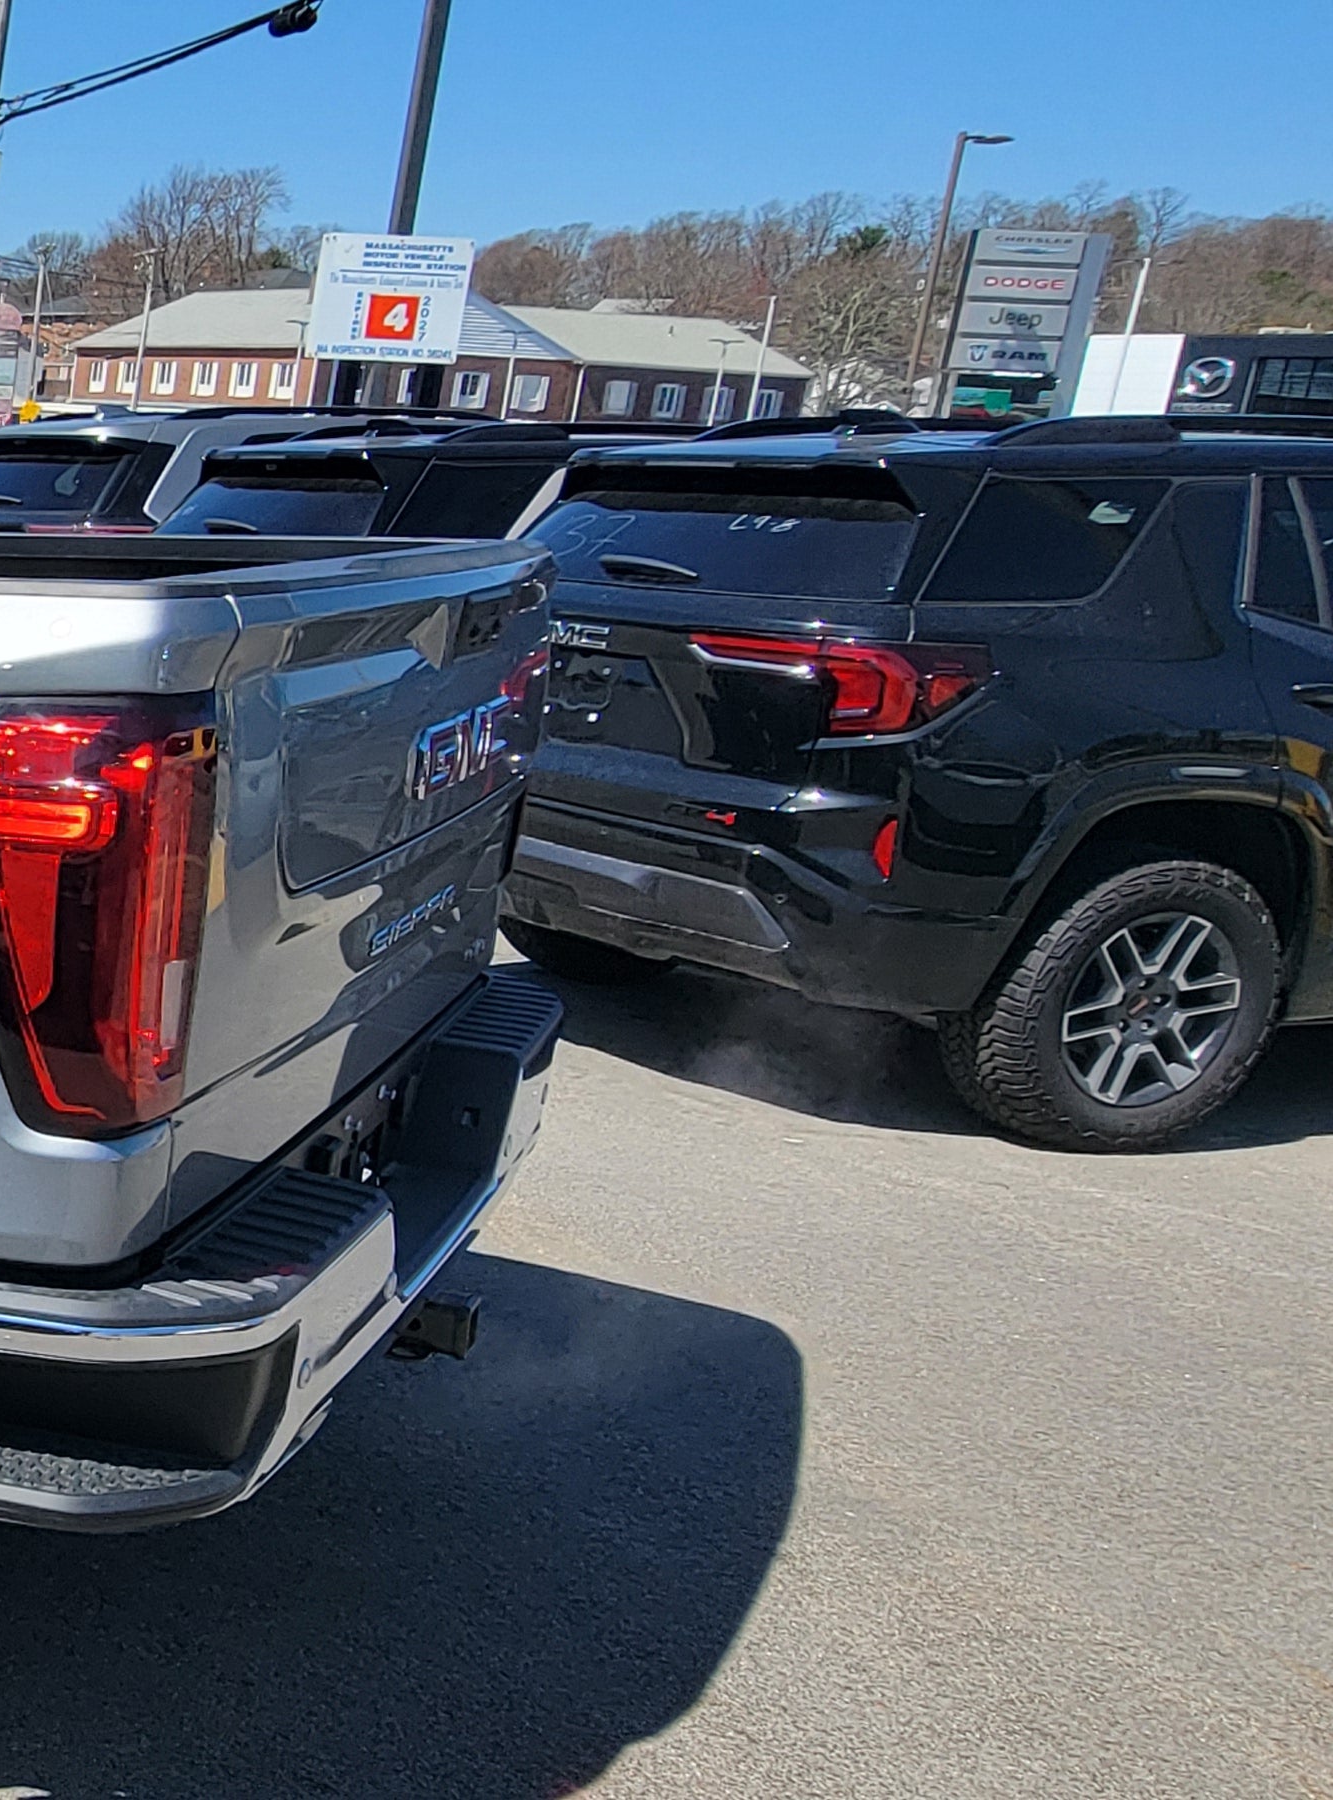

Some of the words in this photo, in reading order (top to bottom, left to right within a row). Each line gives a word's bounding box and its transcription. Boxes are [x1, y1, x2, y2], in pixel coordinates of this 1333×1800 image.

[364, 242, 454, 253] MASSACHUSETTS
[994, 234, 1074, 245] CHRYSLER
[363, 251, 400, 260] MOTOR
[404, 253, 445, 262] VEHICLE
[362, 260, 422, 270] INSPECTION
[426, 263, 467, 272] STATION
[984, 276, 1067, 290] DODGE
[383, 302, 409, 333] 4
[417, 295, 432, 343] 2027
[989, 307, 1043, 330] Jeep
[991, 350, 1049, 361] RAM
[549, 620, 611, 650] MC
[404, 694, 510, 801] GMC
[369, 884, 456, 957] SIERRA
